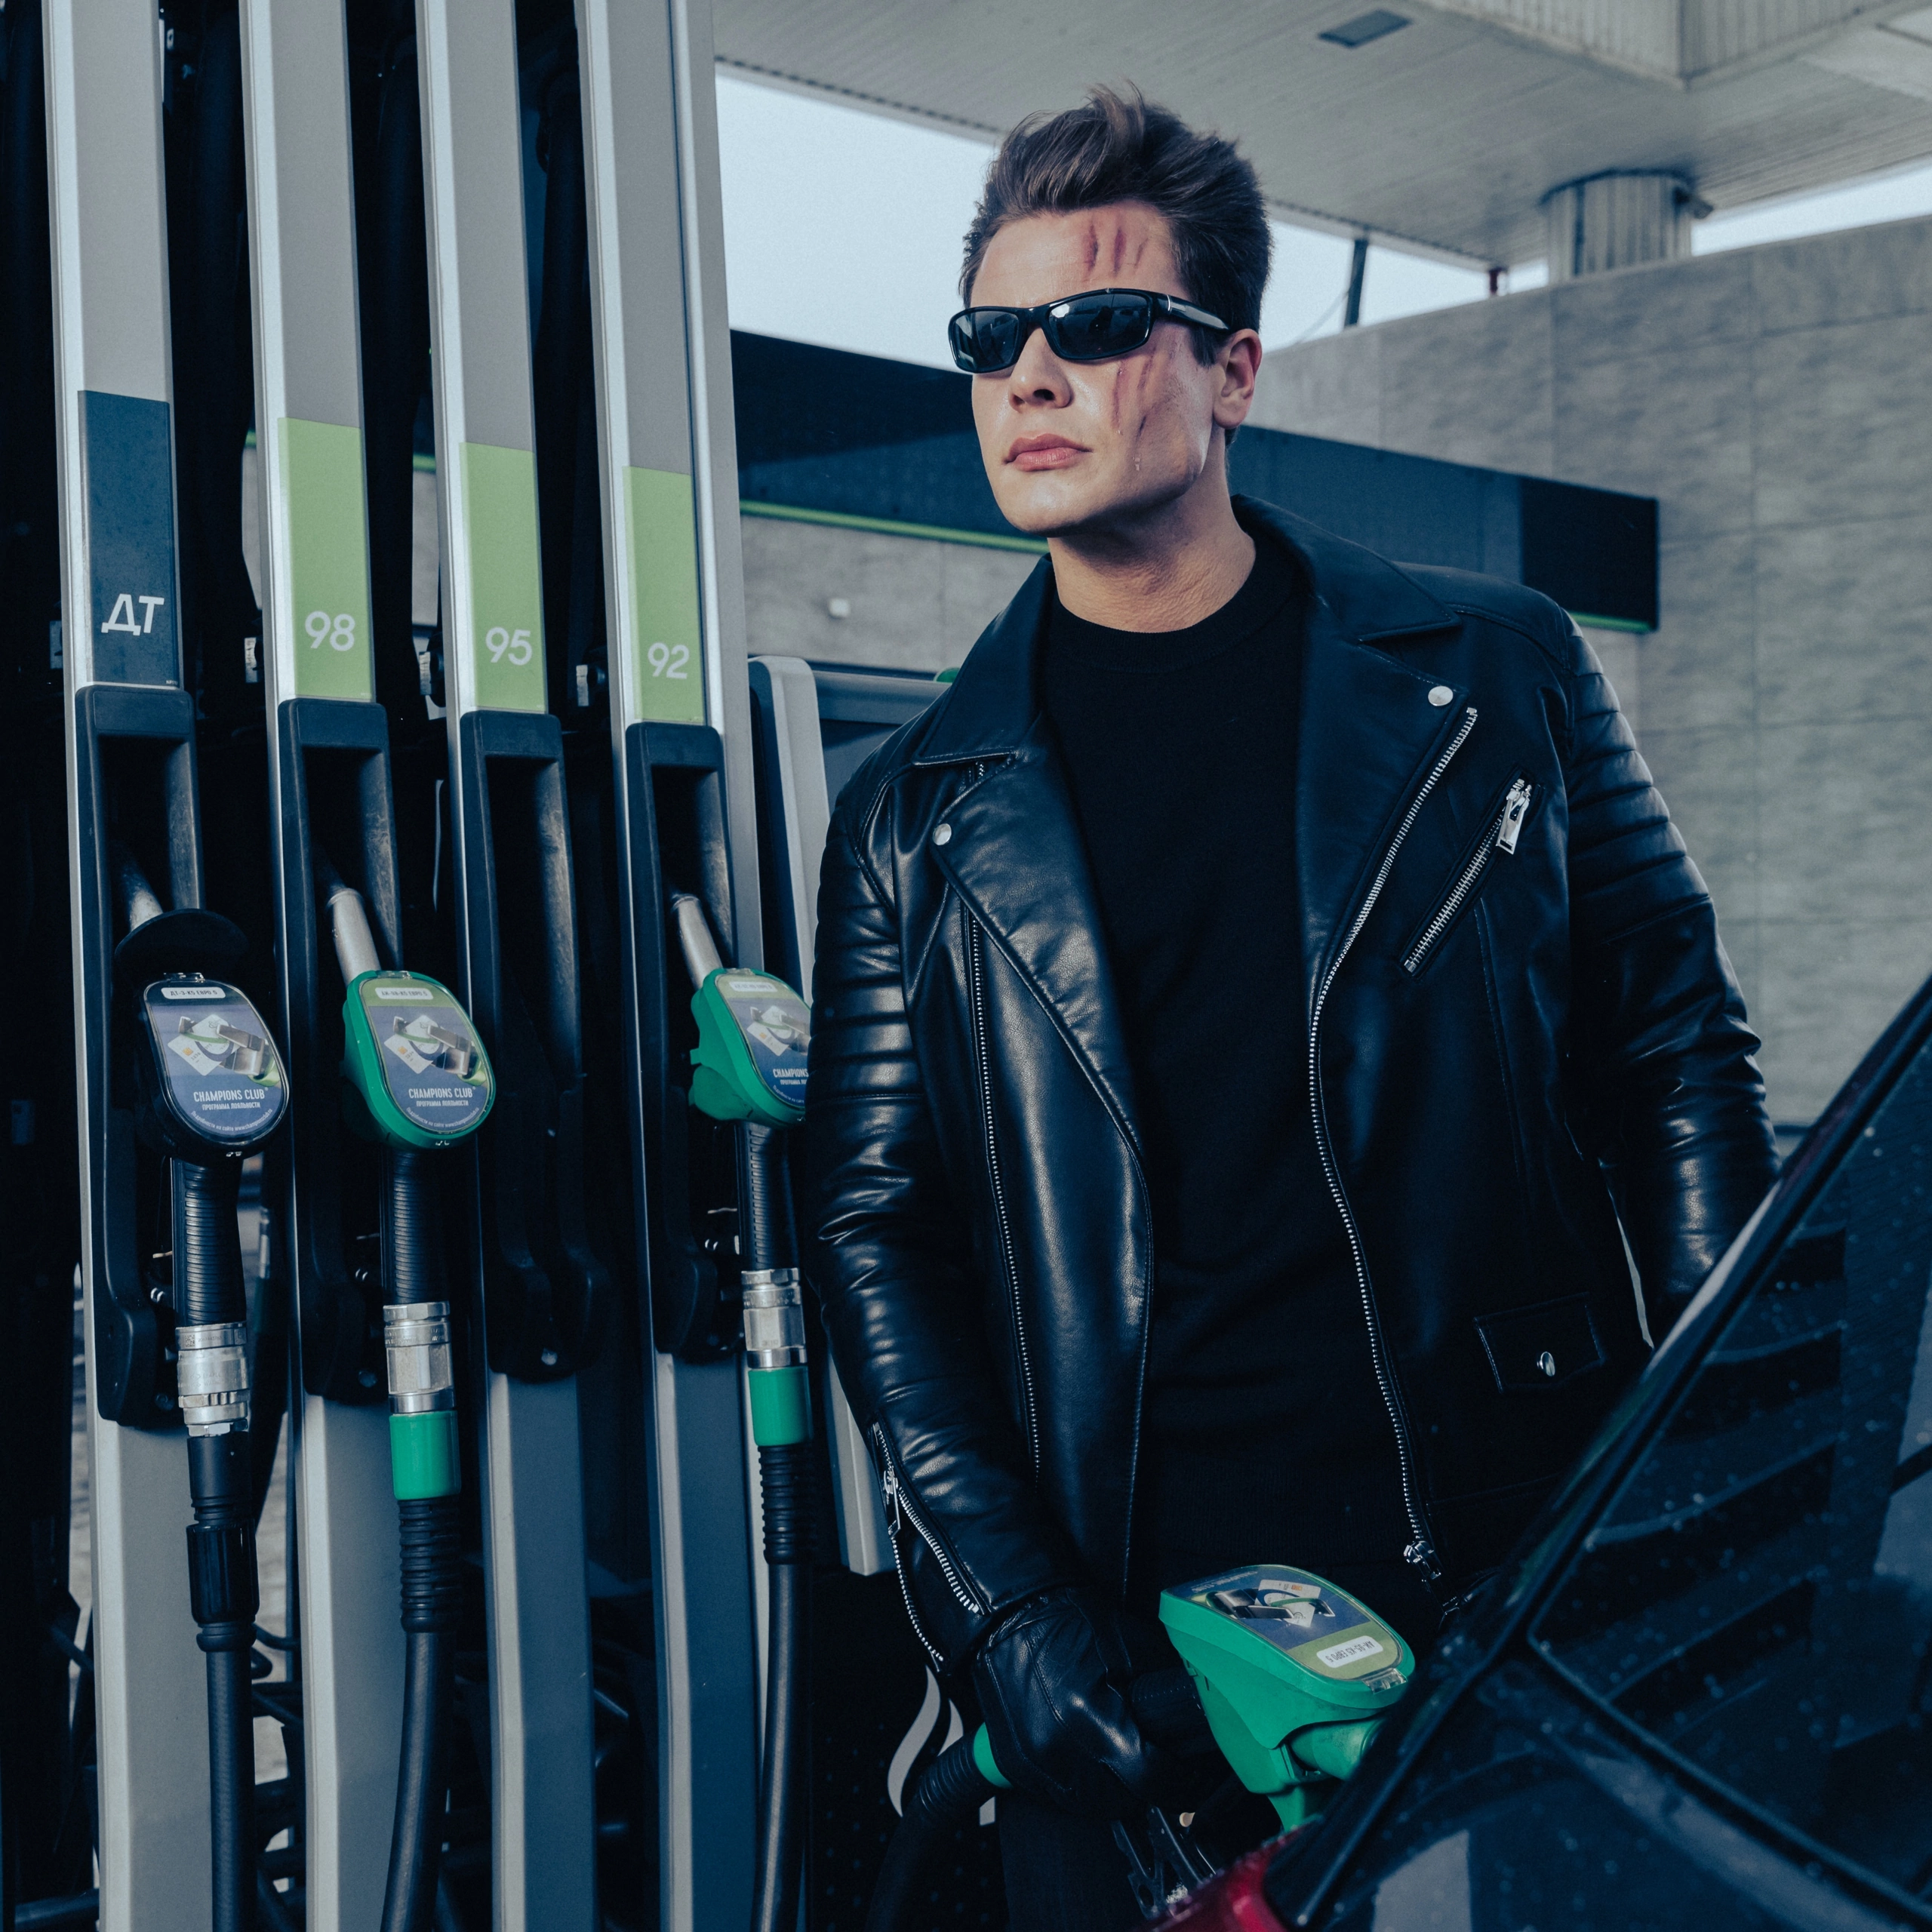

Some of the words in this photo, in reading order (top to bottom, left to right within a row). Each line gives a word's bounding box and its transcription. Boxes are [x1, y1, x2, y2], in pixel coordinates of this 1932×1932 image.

[101, 593, 165, 636] ДТ
[305, 611, 356, 651] 98
[485, 626, 533, 666] 95
[648, 642, 690, 679] 92
[773, 1068, 809, 1078] CHAMPIONS
[193, 1089, 242, 1103] CHAMPIONS
[245, 1088, 265, 1100] CLUB
[408, 1088, 453, 1099] CHAMPIONS
[454, 1088, 473, 1098] CLUB
[1331, 1650, 1349, 1660] ЕВРО
